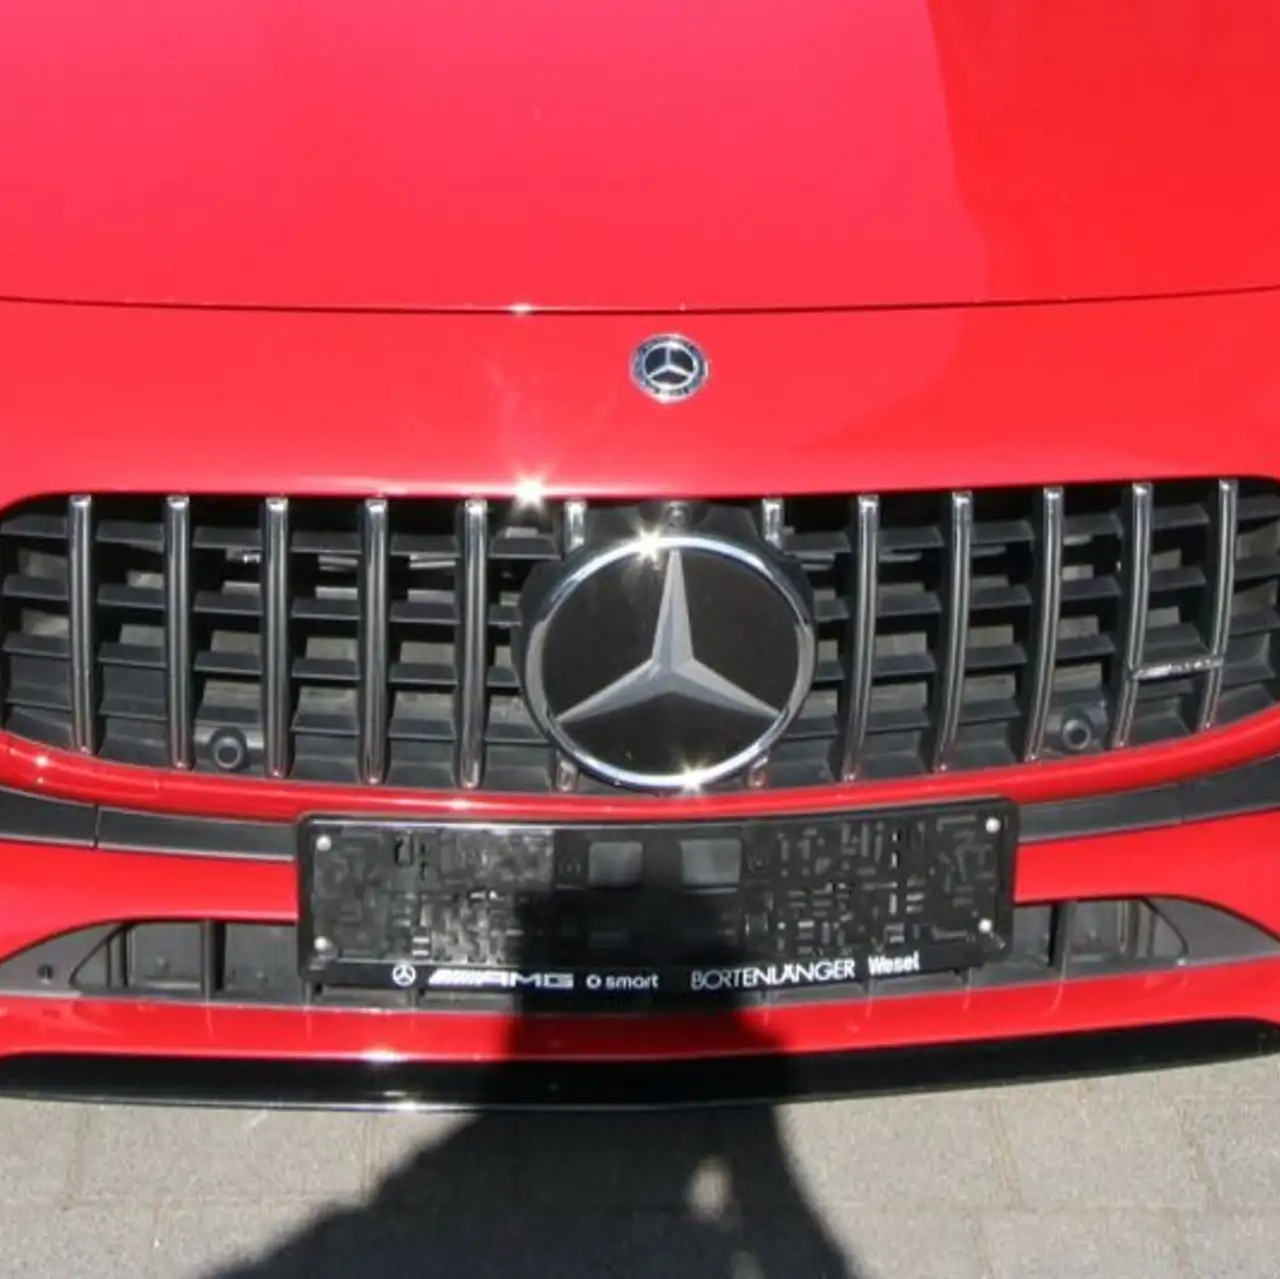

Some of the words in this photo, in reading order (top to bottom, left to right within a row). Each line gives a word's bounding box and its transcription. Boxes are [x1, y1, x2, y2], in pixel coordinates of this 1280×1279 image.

[474, 970, 574, 989] AMG
[604, 974, 659, 990] smart
[690, 958, 856, 990] BORTENLÄNGER
[868, 950, 920, 976] Wesel
